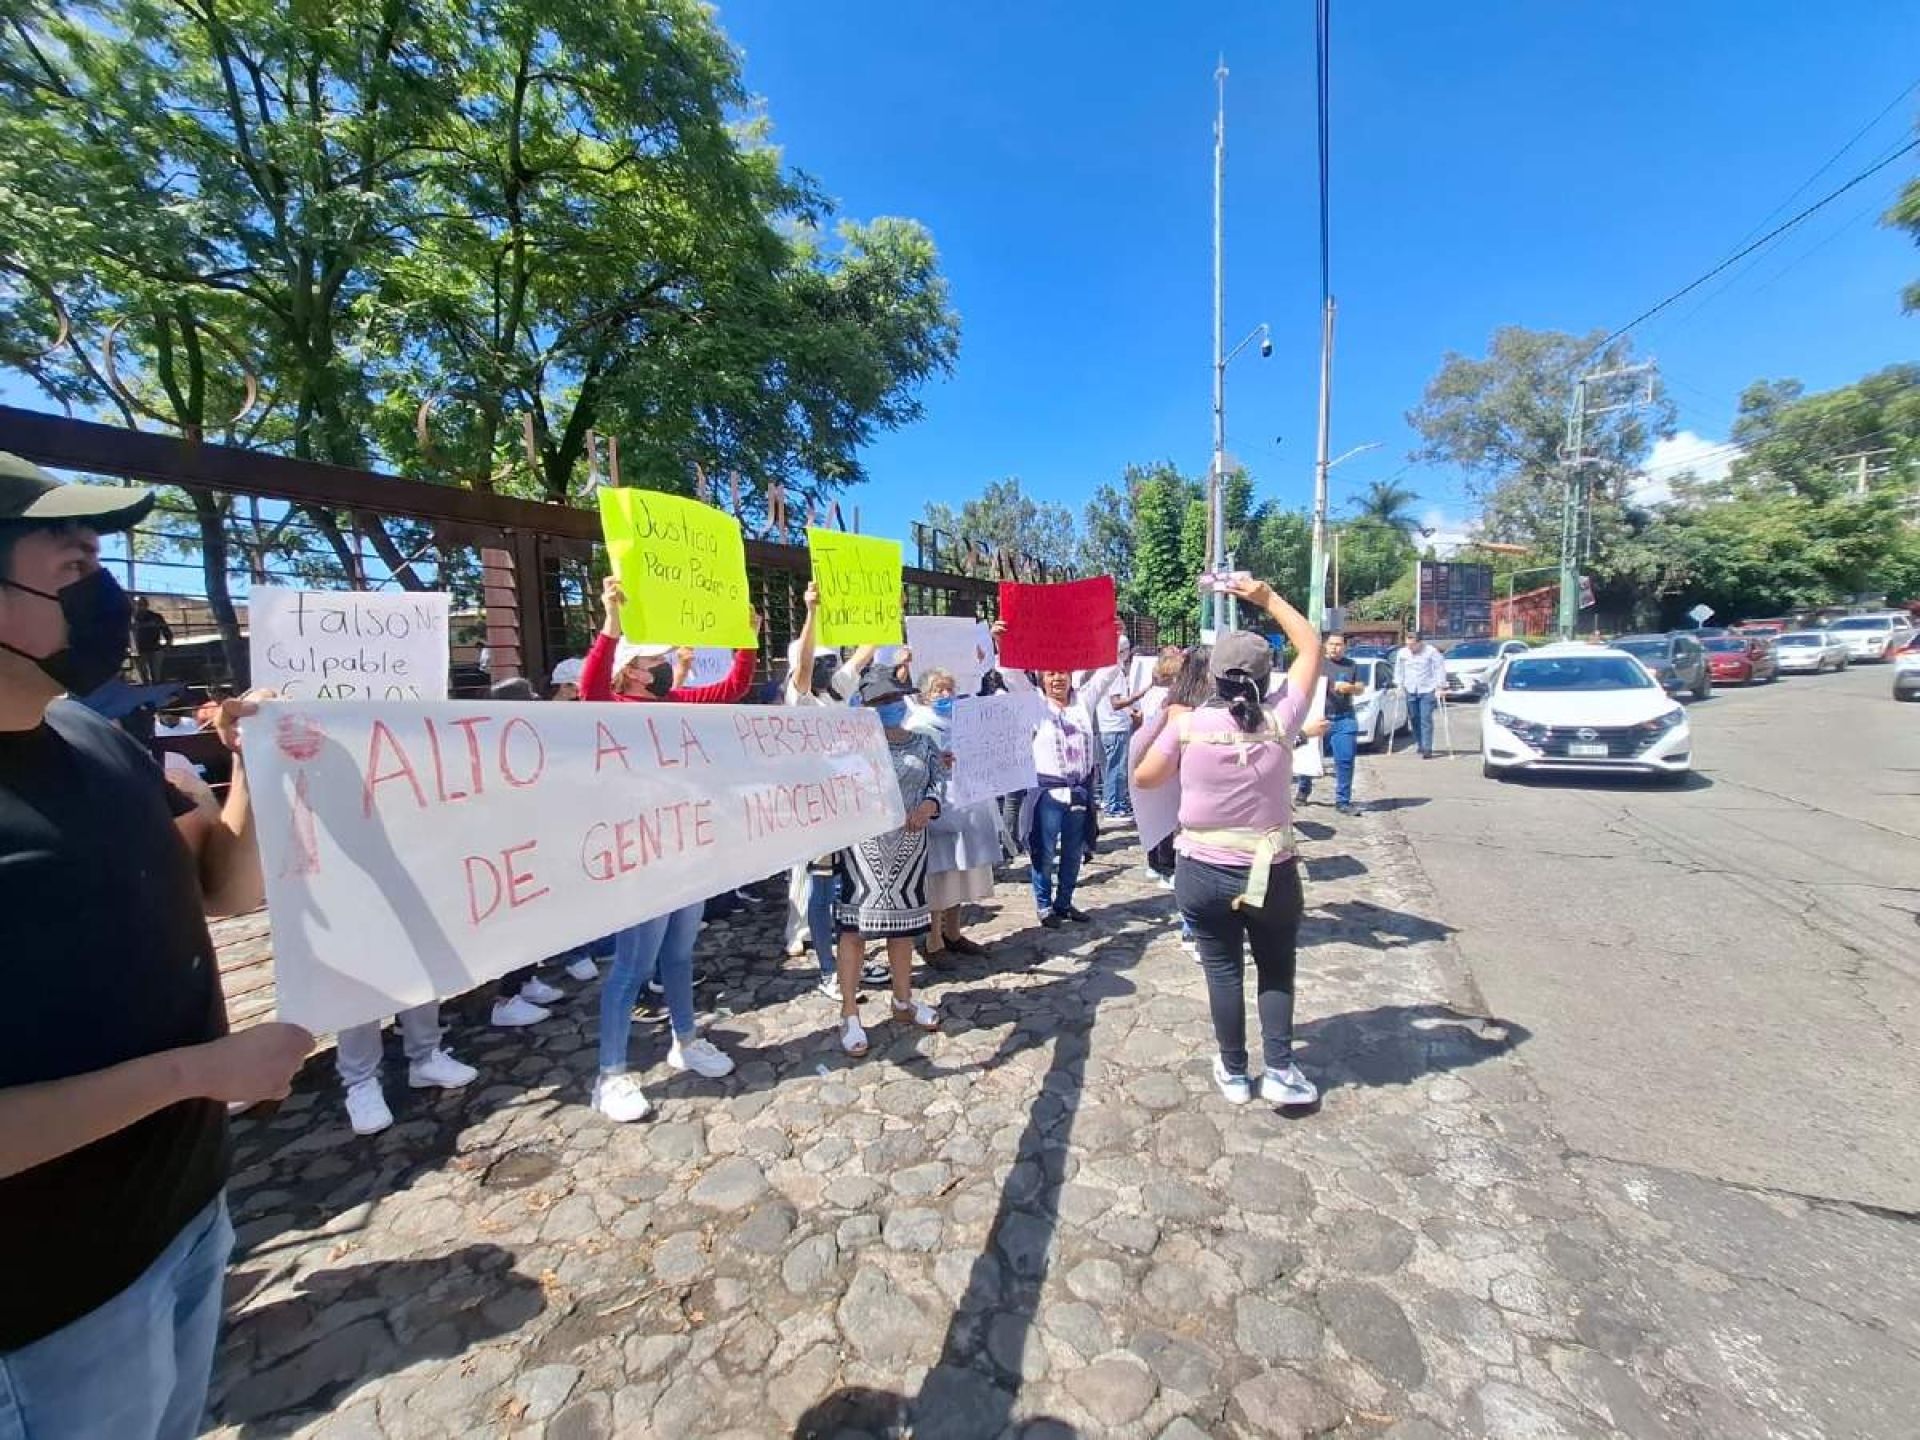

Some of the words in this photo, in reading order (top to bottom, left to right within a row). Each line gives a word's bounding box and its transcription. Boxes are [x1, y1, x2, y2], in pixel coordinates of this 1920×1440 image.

[636, 498, 718, 557] Justicia
[643, 551, 682, 582] Para
[287, 591, 411, 639] Falso
[266, 641, 410, 678] Culpable
[362, 716, 545, 820] ALTO
[594, 719, 631, 773] A
[647, 716, 712, 768] LA
[463, 839, 550, 925] DE
[581, 799, 716, 881] GENTE
